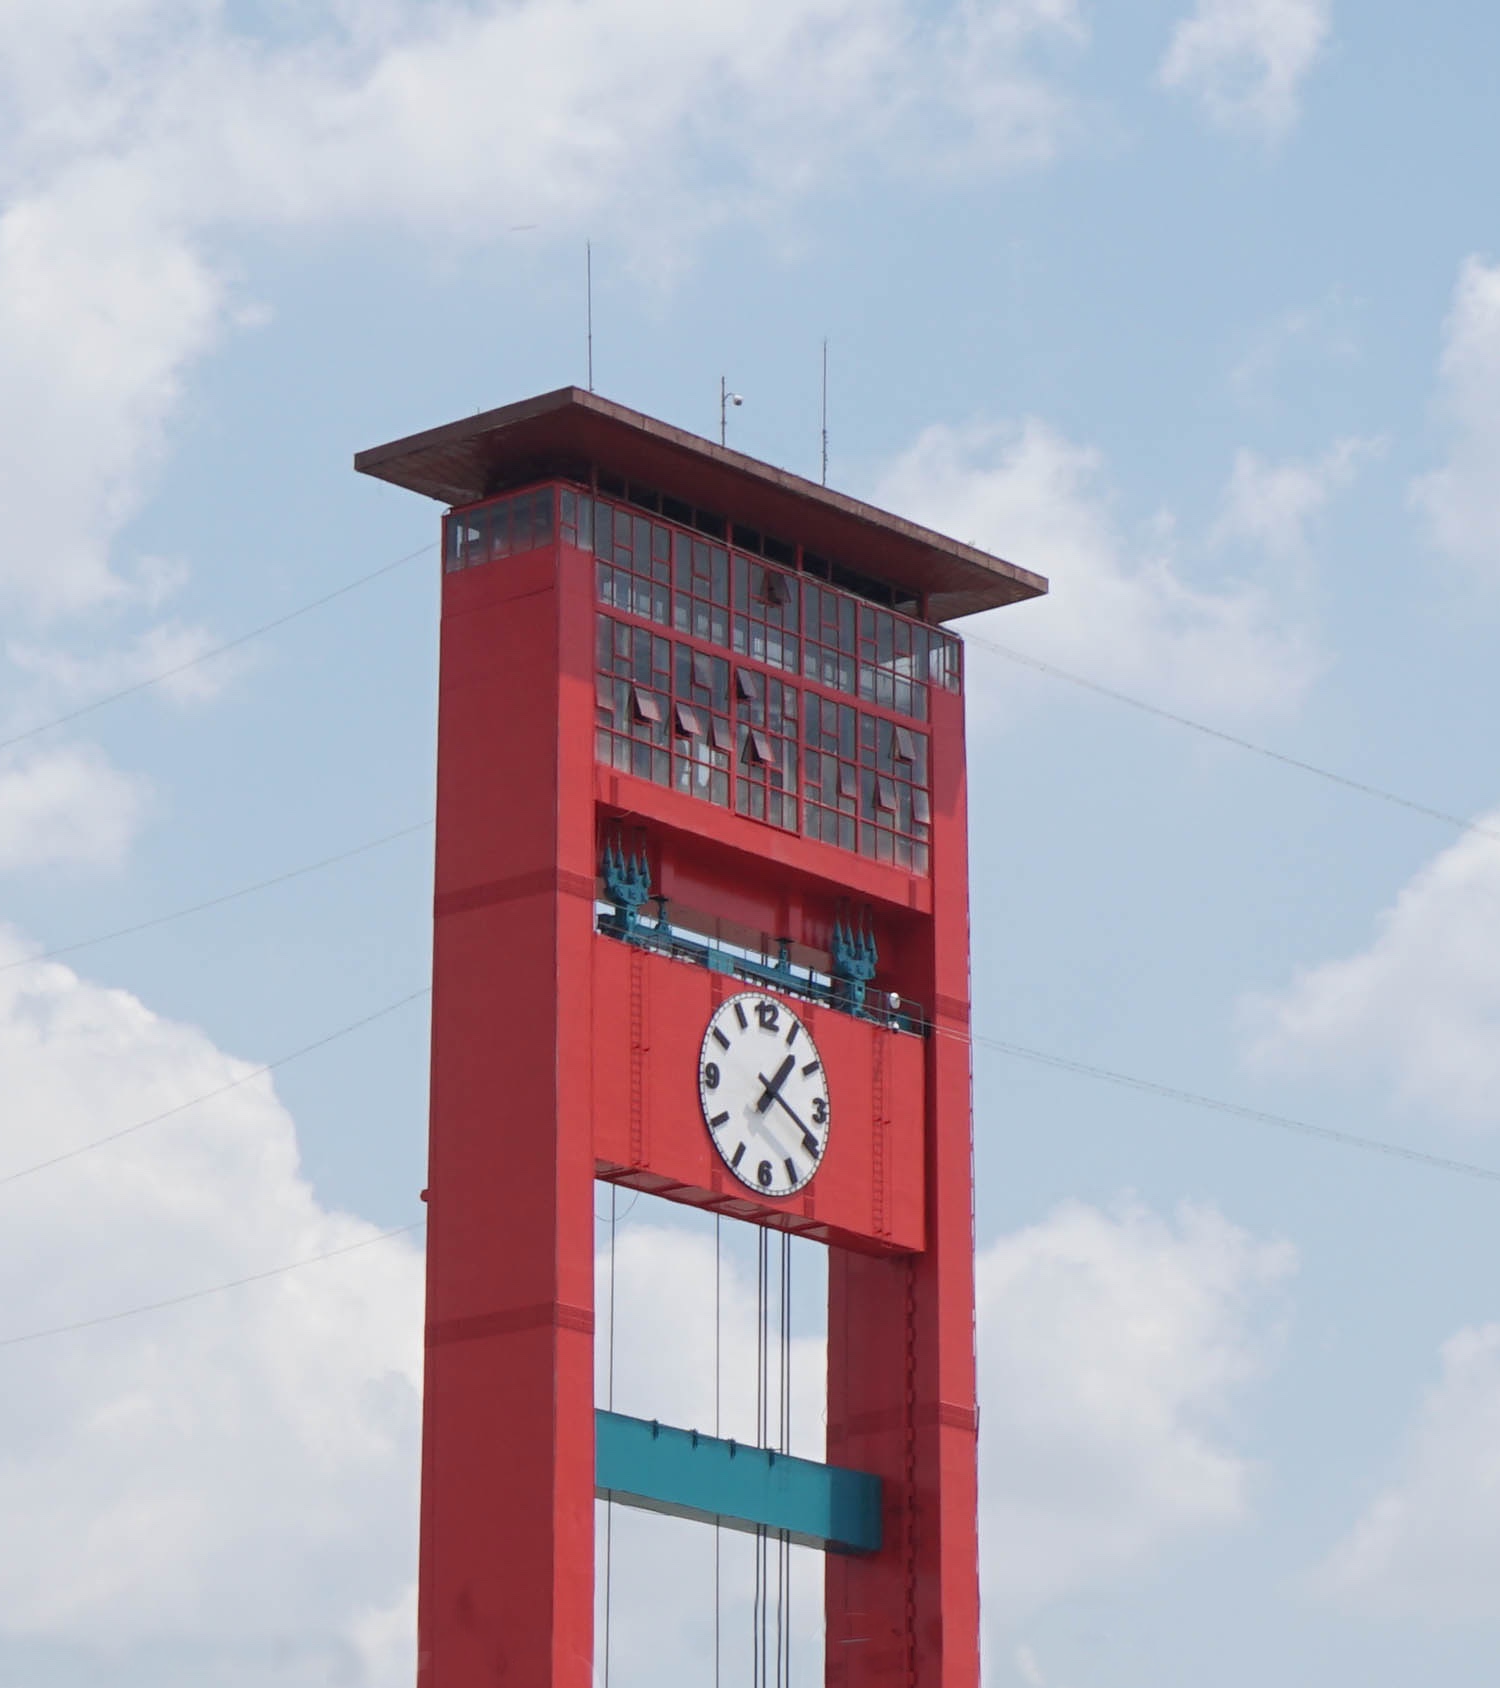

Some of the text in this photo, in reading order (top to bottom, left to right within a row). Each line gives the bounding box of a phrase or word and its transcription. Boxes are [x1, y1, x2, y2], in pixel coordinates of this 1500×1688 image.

[754, 1000, 780, 1033] 12
[704, 1062, 720, 1090] 9
[812, 1097, 827, 1124] 3
[757, 1160, 773, 1187] 6
